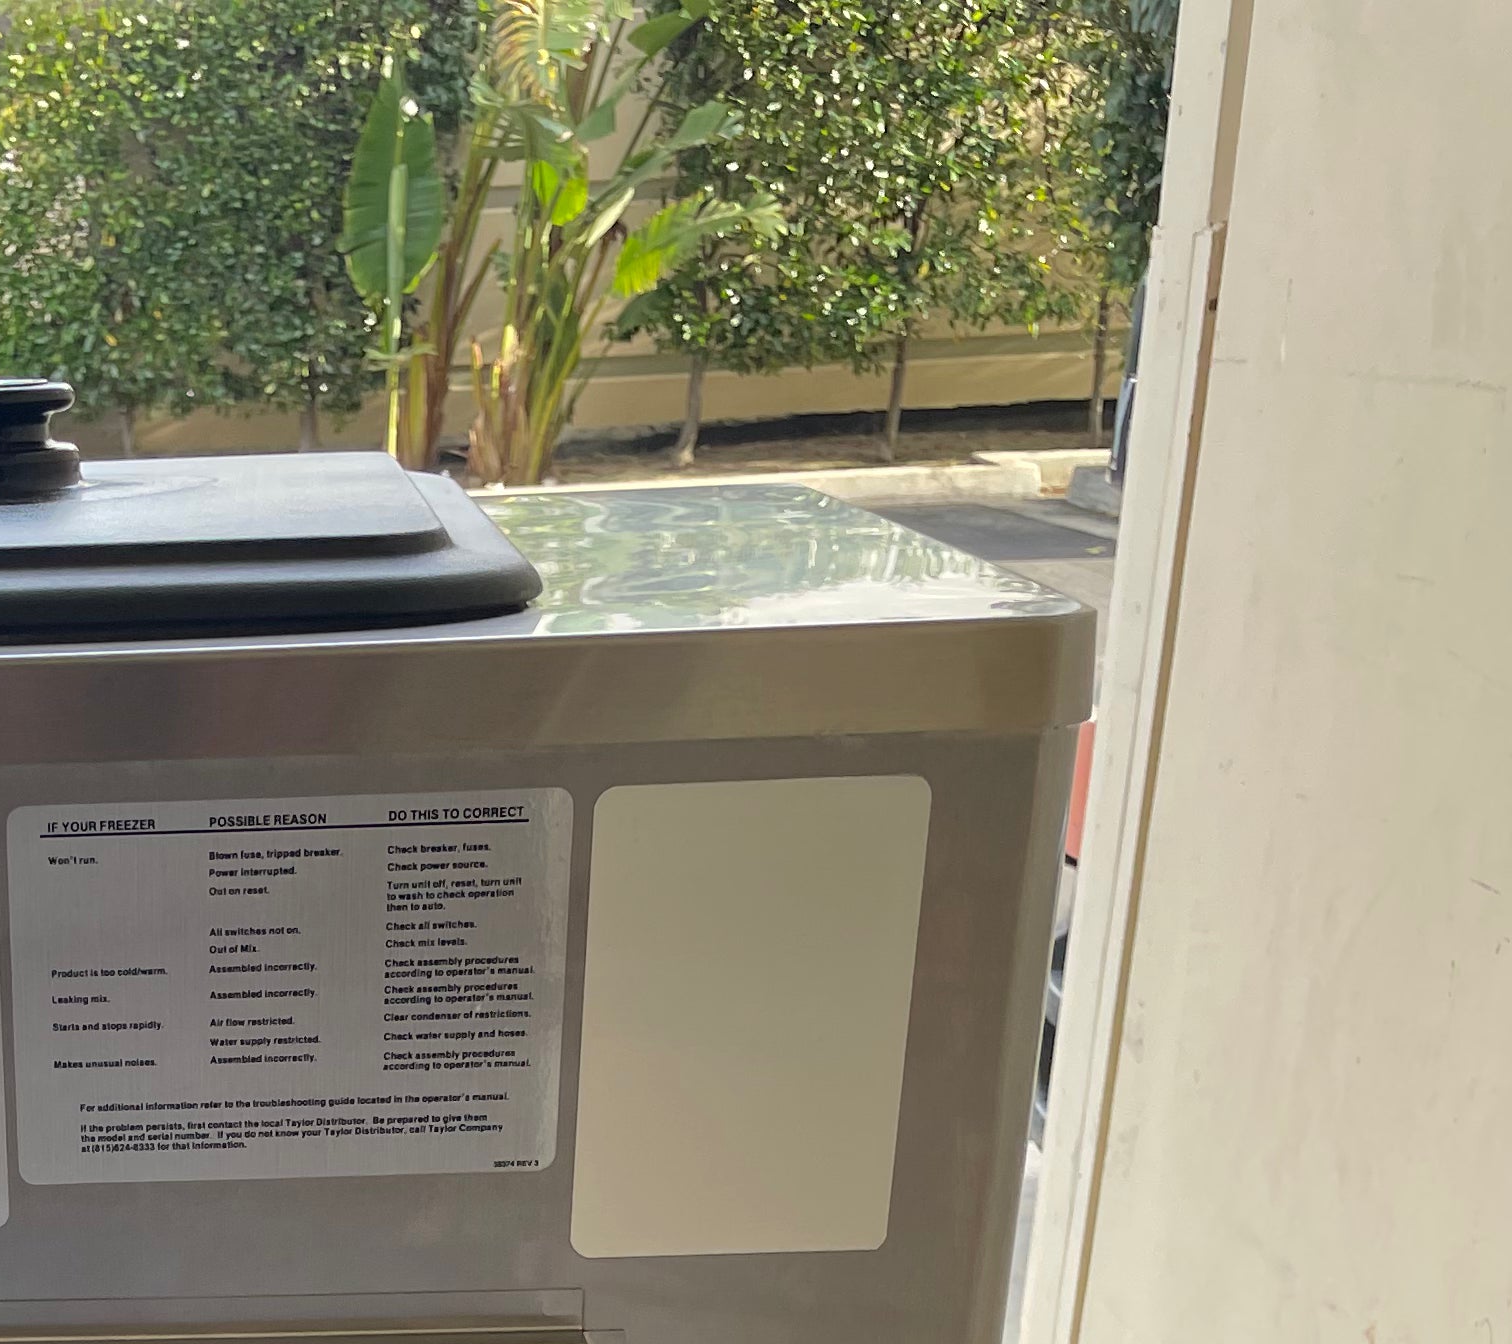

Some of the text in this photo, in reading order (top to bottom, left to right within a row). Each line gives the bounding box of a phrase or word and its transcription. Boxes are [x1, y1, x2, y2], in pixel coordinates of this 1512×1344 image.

[388, 805, 524, 821] DO THIS TO CORRECT
[47, 818, 155, 832] IF YOUR FREEZER
[208, 812, 326, 827] POSSIBLE REASON
[266, 847, 301, 859] tripped
[387, 844, 417, 854] Check
[462, 842, 490, 851] fuses.
[208, 866, 296, 877] Power interrupted.
[387, 861, 488, 871] Check power source.
[386, 880, 409, 890] Turn
[411, 879, 430, 889] unit
[480, 878, 500, 886] turn
[502, 876, 521, 885] unit
[208, 886, 269, 896] Out on reset.
[386, 888, 514, 901] to wash to check operation
[386, 901, 445, 912] then to auto.
[208, 927, 222, 936] All
[224, 926, 266, 936] switches
[268, 926, 284, 934] not
[385, 920, 476, 931] Check all switches.
[385, 937, 466, 948] Check mix levels.
[208, 943, 259, 954] Out of Mix.
[384, 956, 519, 967] Check assembly procedures
[51, 969, 88, 978] Product
[89, 968, 98, 976] is
[100, 968, 115, 976] too
[208, 962, 316, 973] Assembled incorrectly.
[384, 965, 533, 979] according to operator's manual.
[209, 988, 315, 999] Assembled incorrectly.
[383, 983, 518, 994] Check assembly procedures
[51, 994, 109, 1005] Leaking mix.
[383, 991, 533, 1005] according to operator's manual.
[383, 1009, 530, 1021] Clear condenser of restrictions.
[52, 1022, 79, 1031] Starts
[81, 1021, 99, 1030] and
[101, 1022, 127, 1031] stops
[209, 1016, 294, 1027] Air flow restricted.
[209, 1034, 320, 1047] Water supply restricted.
[383, 1029, 527, 1041] Check water supply and hoses.
[210, 1053, 316, 1064] Assembled incorrectly.
[383, 1049, 515, 1060] Check assembly procedures
[53, 1058, 157, 1068] Makes unusual noises.
[382, 1058, 531, 1071] according to operator's manual.
